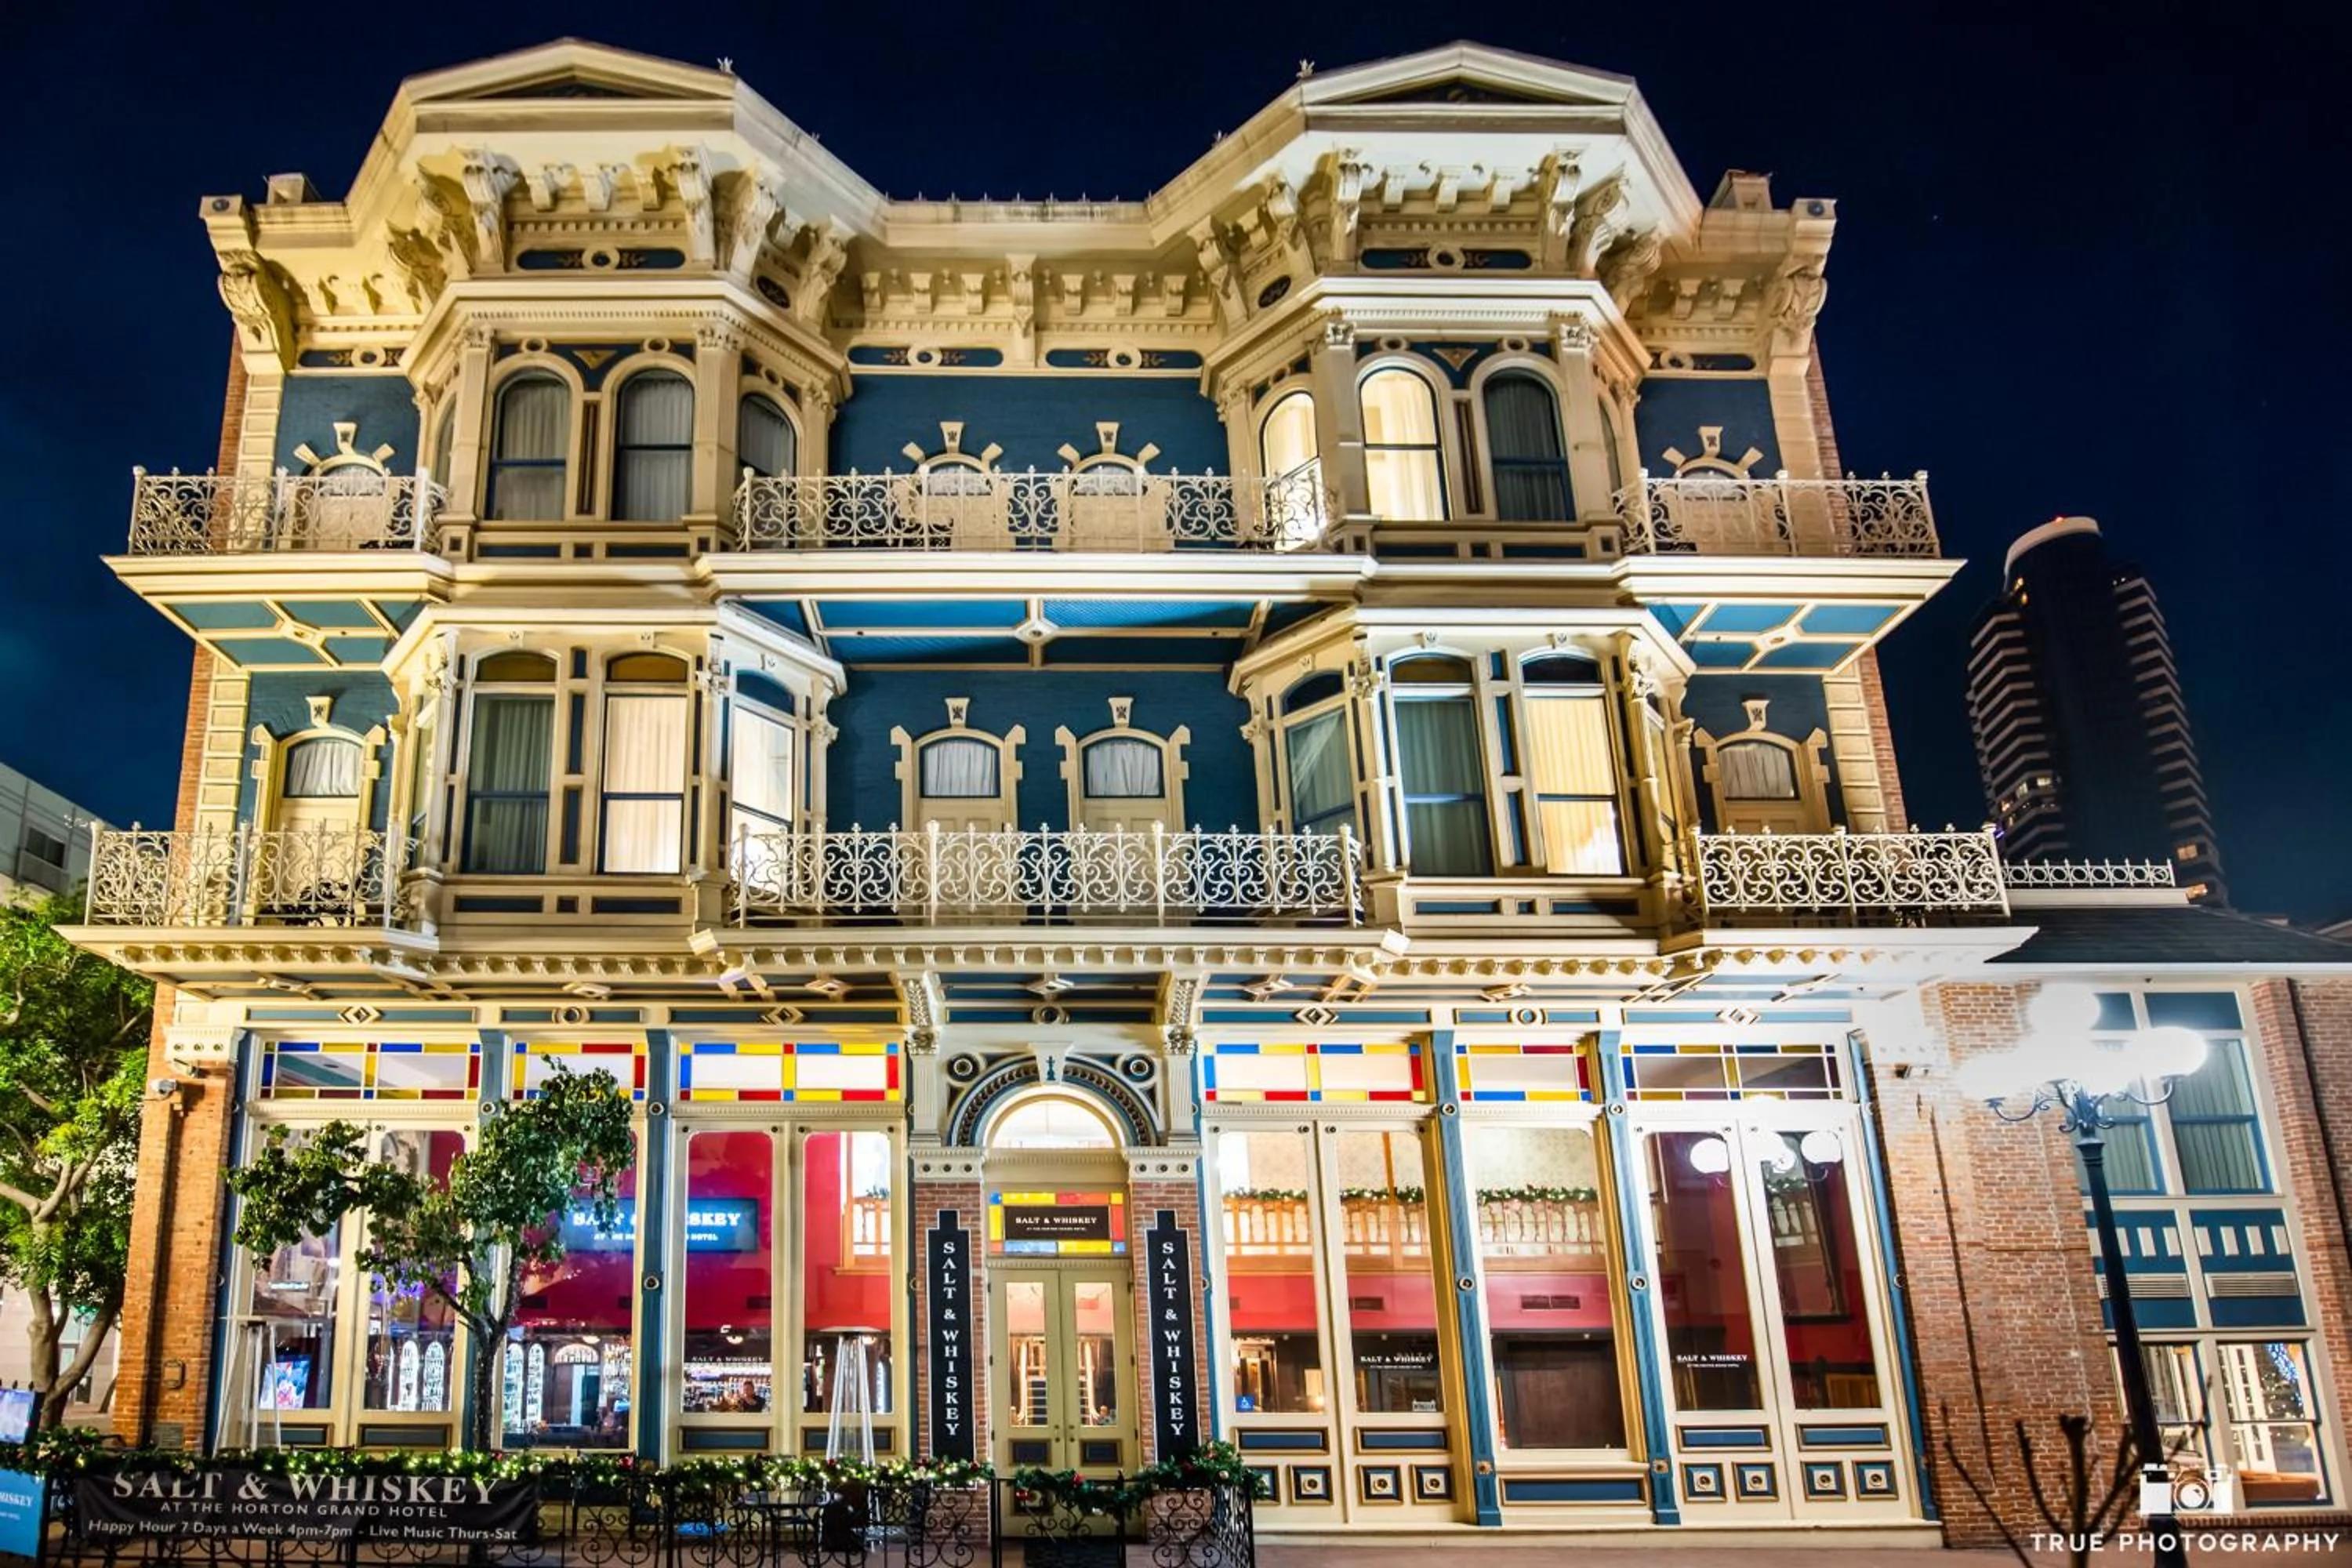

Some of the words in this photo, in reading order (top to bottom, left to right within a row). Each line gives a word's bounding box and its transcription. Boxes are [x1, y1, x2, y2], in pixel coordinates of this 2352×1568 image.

[573, 1212, 625, 1225] SAT
[942, 1241, 957, 1299] SALT
[1162, 1241, 1177, 1299] SALT
[943, 1308, 956, 1320] &
[1165, 1308, 1178, 1321] &
[1676, 1354, 1699, 1363] SALT
[942, 1330, 960, 1436] WHISKEY
[1164, 1330, 1185, 1436] WHISKEY
[113, 1471, 223, 1498] SALT
[238, 1472, 269, 1500] &
[288, 1473, 499, 1504] WHISKEY
[161, 1501, 182, 1512] AT
[191, 1502, 223, 1513] THE
[231, 1503, 309, 1515] HORTON
[318, 1504, 380, 1516] GRAND
[389, 1506, 448, 1518] HOTEL
[89, 1519, 135, 1534] Happy
[140, 1520, 176, 1533] Hour
[181, 1522, 189, 1533] 7
[194, 1523, 227, 1536] Days
[231, 1525, 238, 1534] a
[242, 1522, 283, 1535] Week
[287, 1523, 353, 1539] 4pm-7pm
[369, 1525, 399, 1537] Live
[404, 1526, 442, 1538] Music
[448, 1526, 518, 1541] Thurs-Sat
